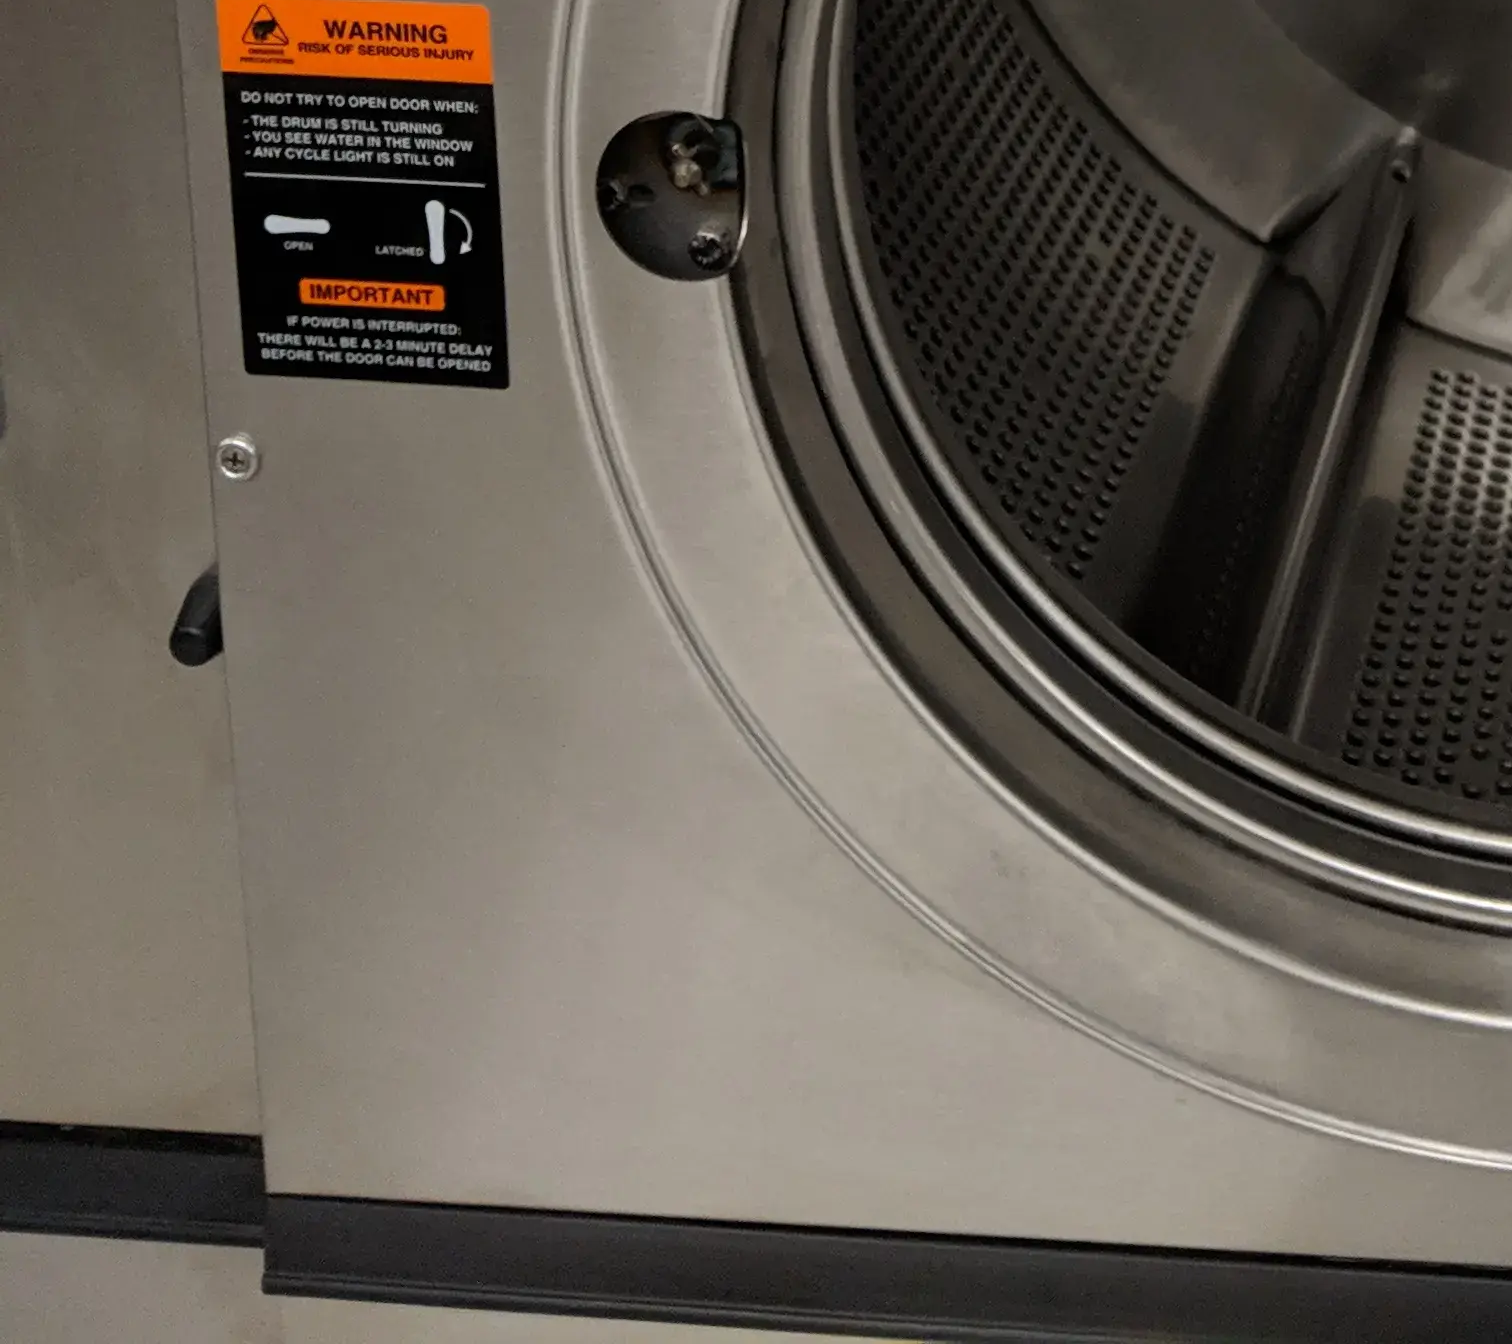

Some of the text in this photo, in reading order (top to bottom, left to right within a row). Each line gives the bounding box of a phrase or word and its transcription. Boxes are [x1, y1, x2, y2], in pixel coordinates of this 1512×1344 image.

[324, 20, 447, 43] WARNING
[298, 43, 329, 53] RISK
[335, 44, 350, 53] OF
[358, 45, 420, 58] SERIOUS
[424, 49, 473, 60] INJURY
[241, 92, 478, 113] DO NOT TRY TO OPEN DOOR WHEN:
[310, 284, 434, 305] IMPORTANT
